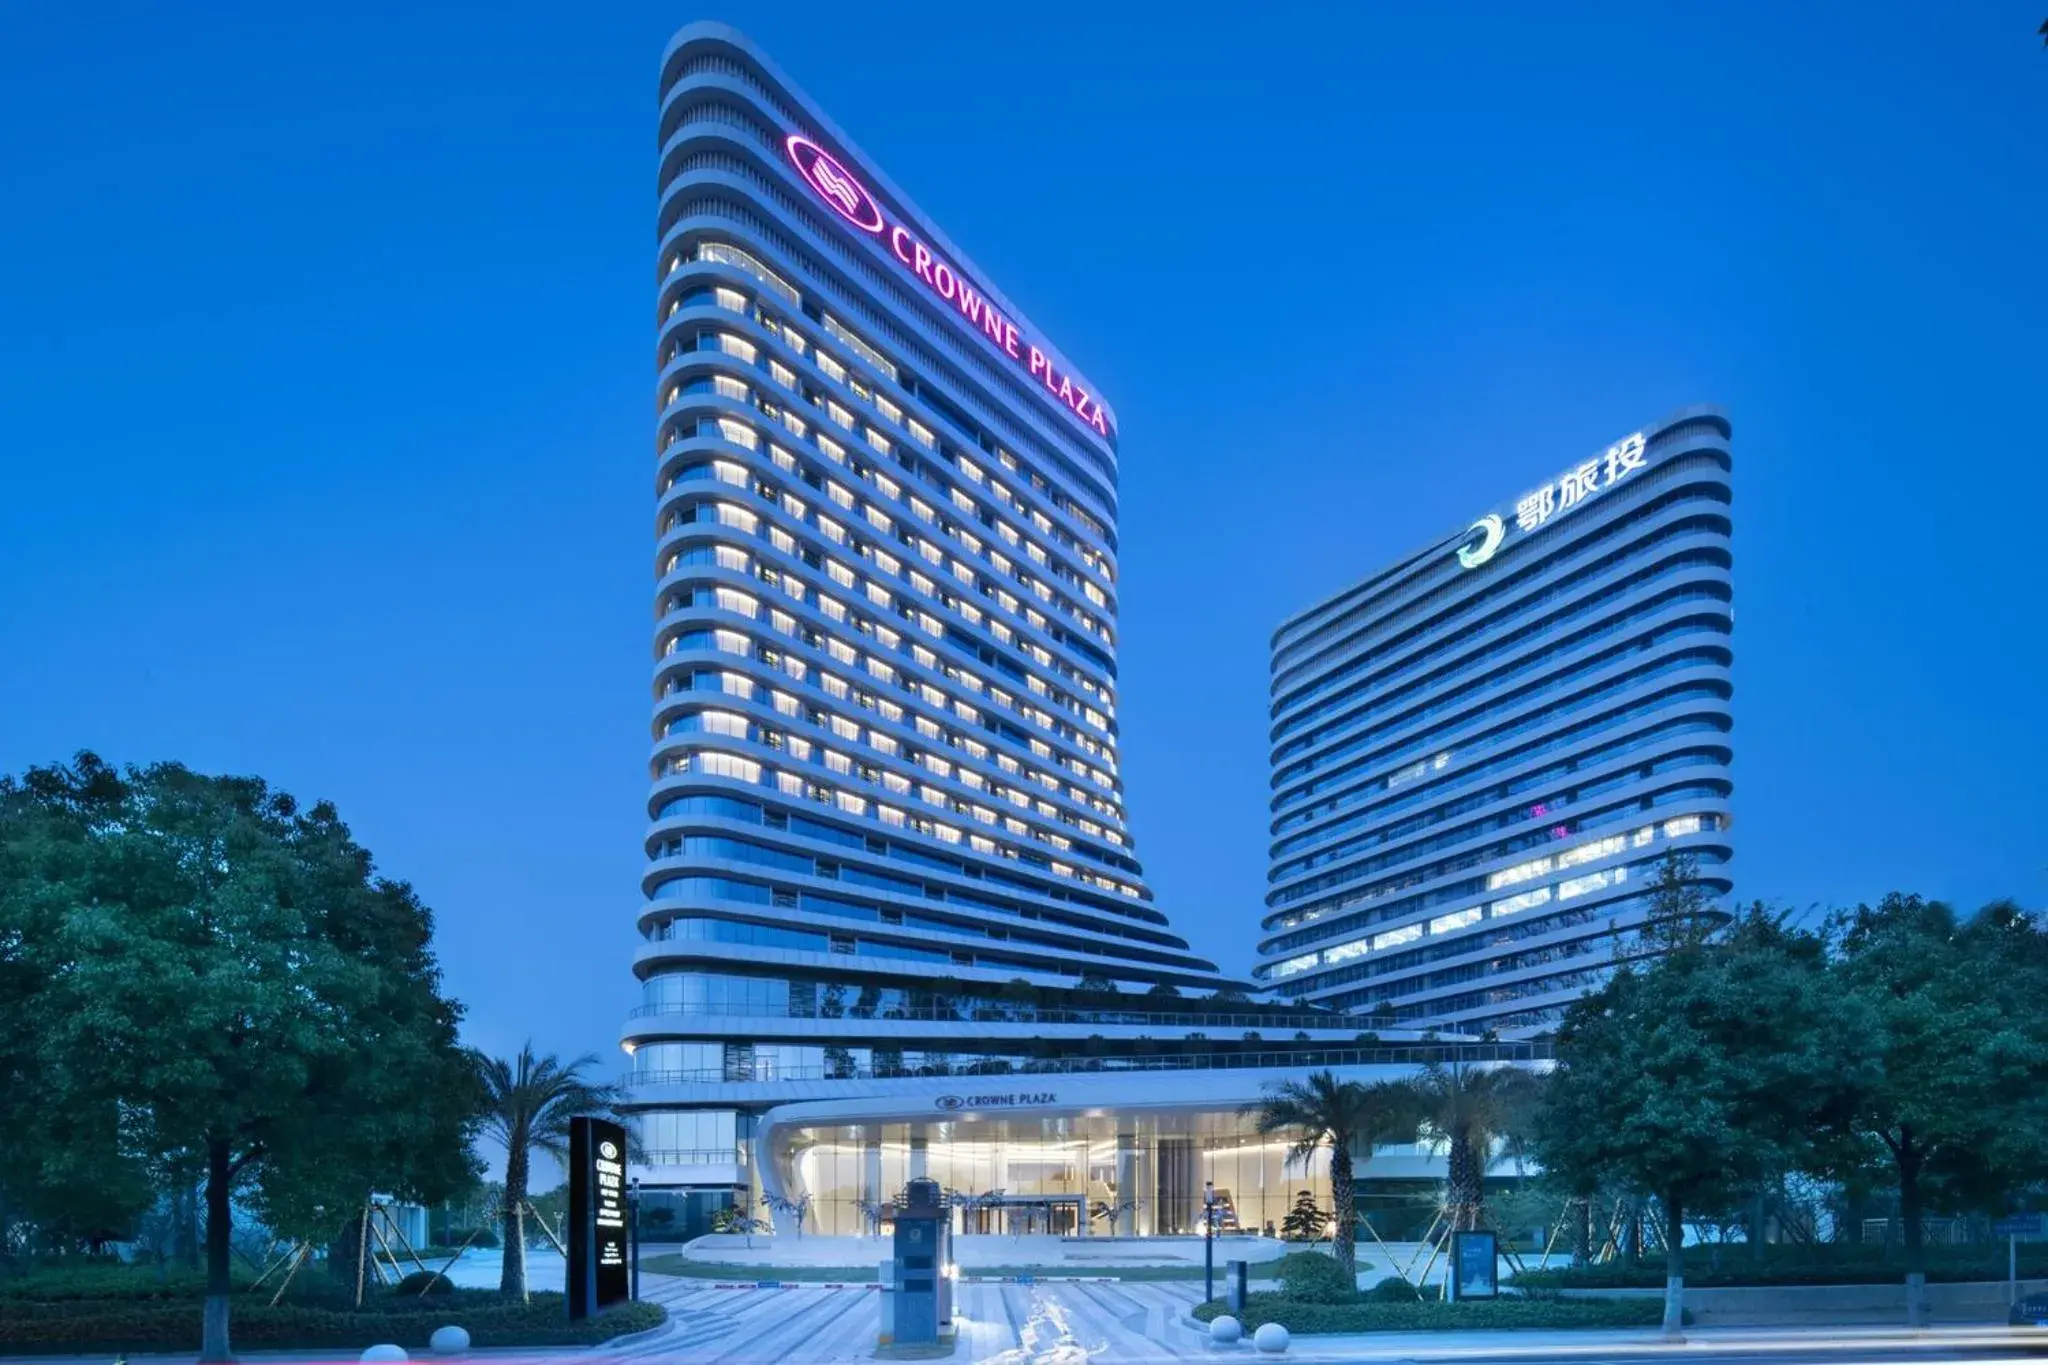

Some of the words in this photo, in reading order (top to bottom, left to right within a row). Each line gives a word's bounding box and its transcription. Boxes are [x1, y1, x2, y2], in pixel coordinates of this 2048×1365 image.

[891, 226, 1021, 358] CROWNE
[1030, 345, 1107, 435] PLAZA
[1516, 432, 1648, 532] 鄂旅投
[967, 1094, 1014, 1106] CROWNE
[1019, 1092, 1057, 1104] PLAZA
